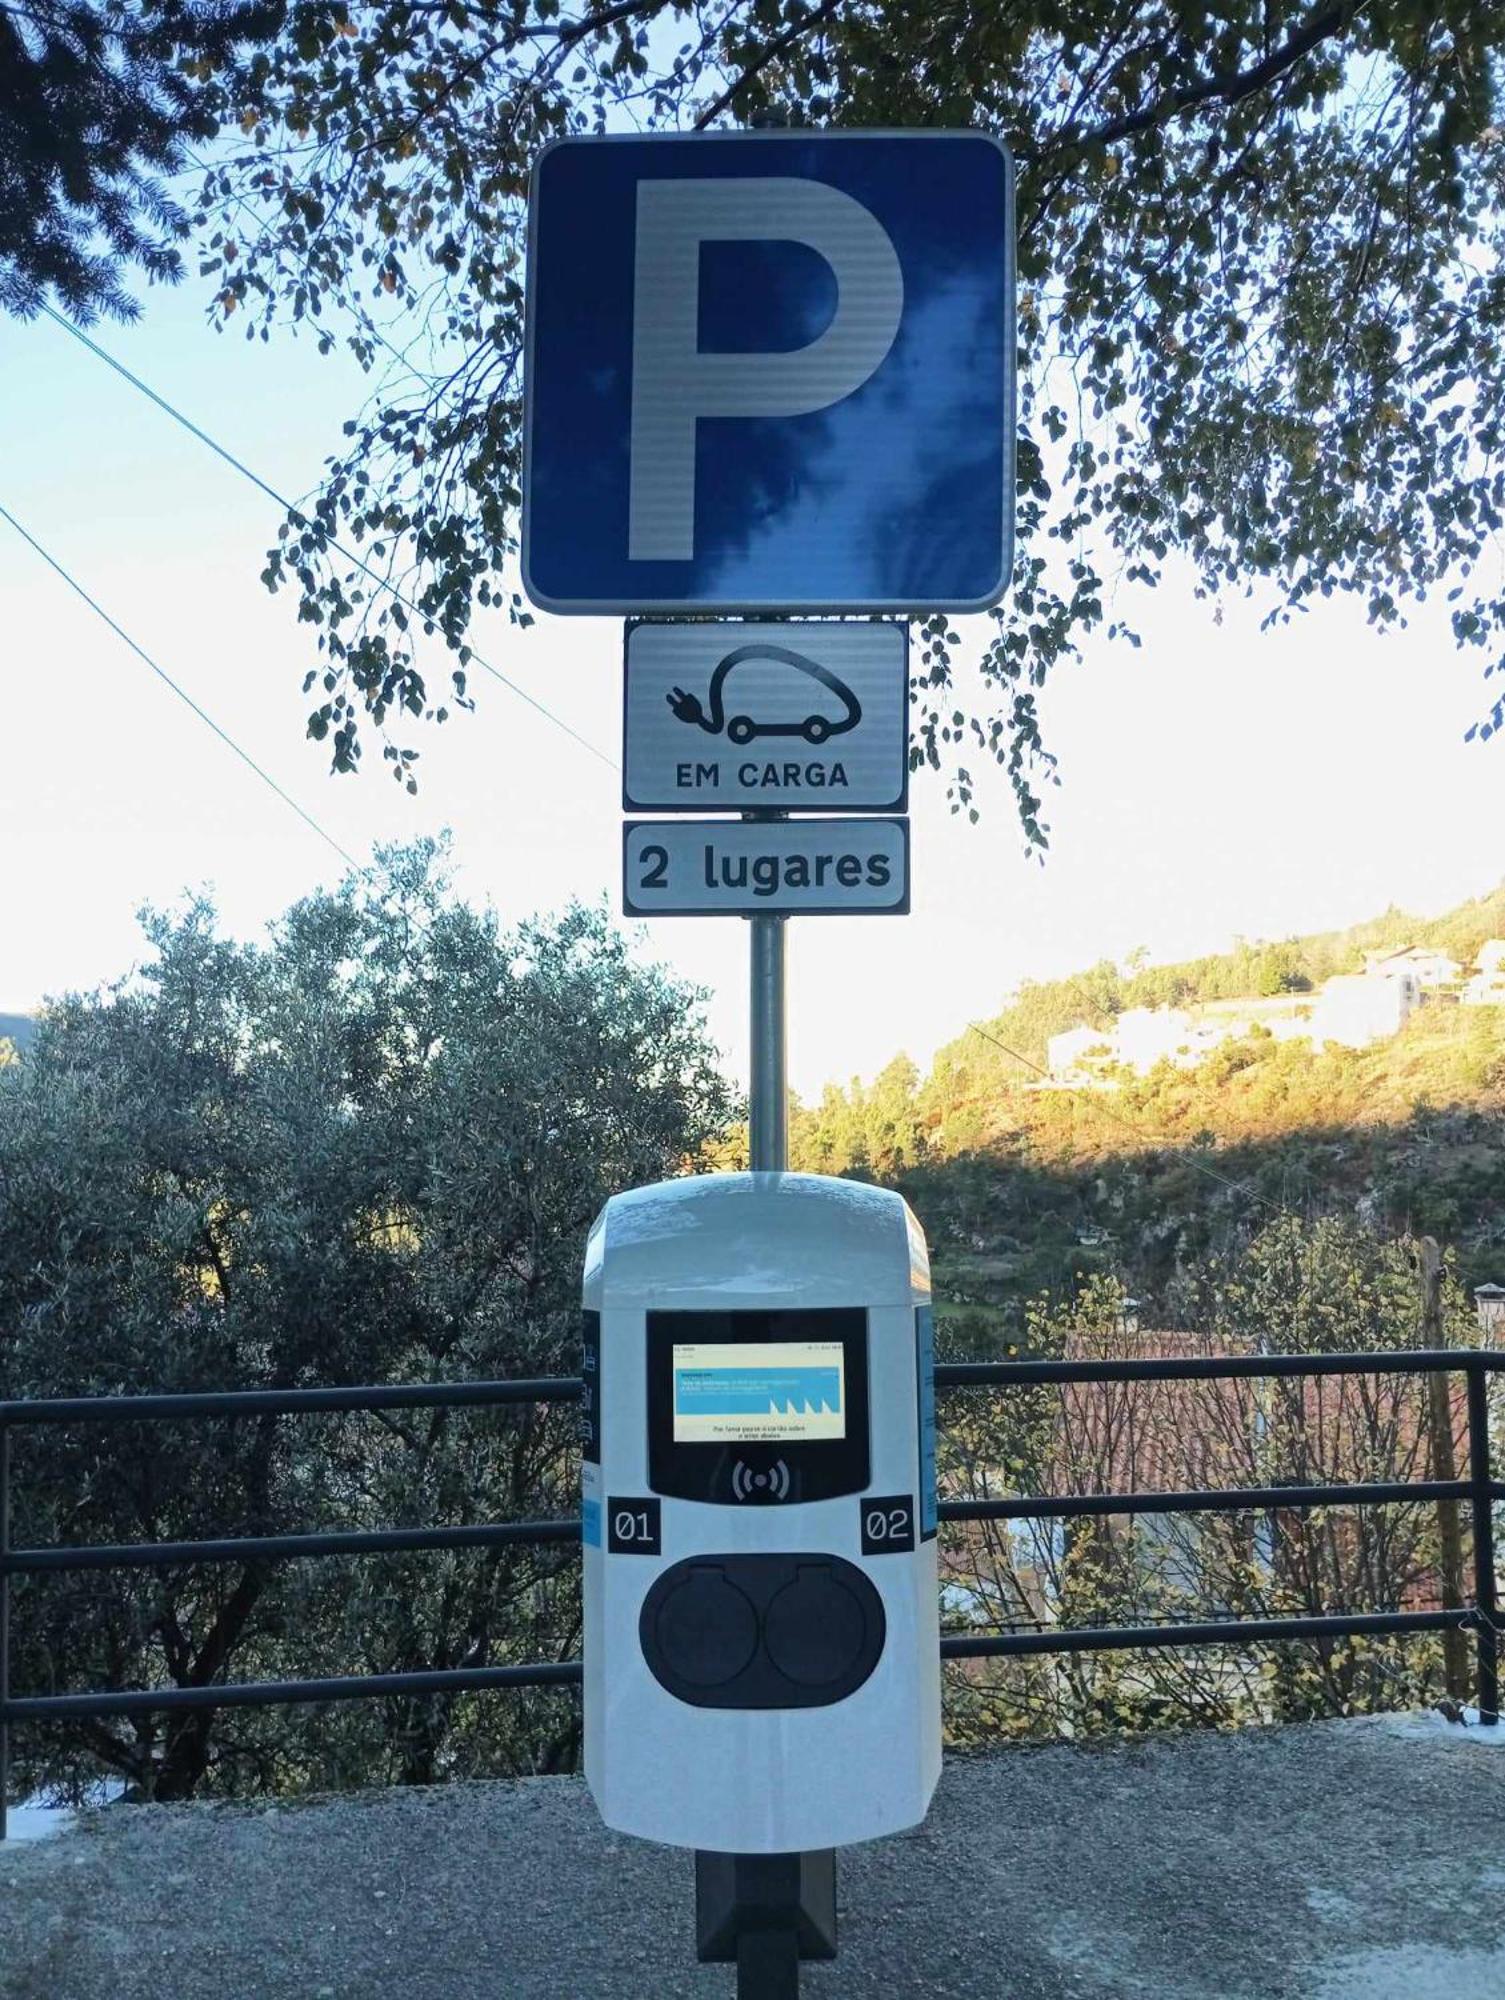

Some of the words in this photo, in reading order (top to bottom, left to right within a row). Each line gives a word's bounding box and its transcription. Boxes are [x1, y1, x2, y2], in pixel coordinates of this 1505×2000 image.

[628, 177, 904, 562] P
[676, 763, 720, 788] EM
[738, 763, 849, 788] CARGA
[639, 845, 669, 889] 2
[704, 845, 891, 897] lugares
[615, 1511, 654, 1541] 01
[866, 1509, 909, 1540] 02
